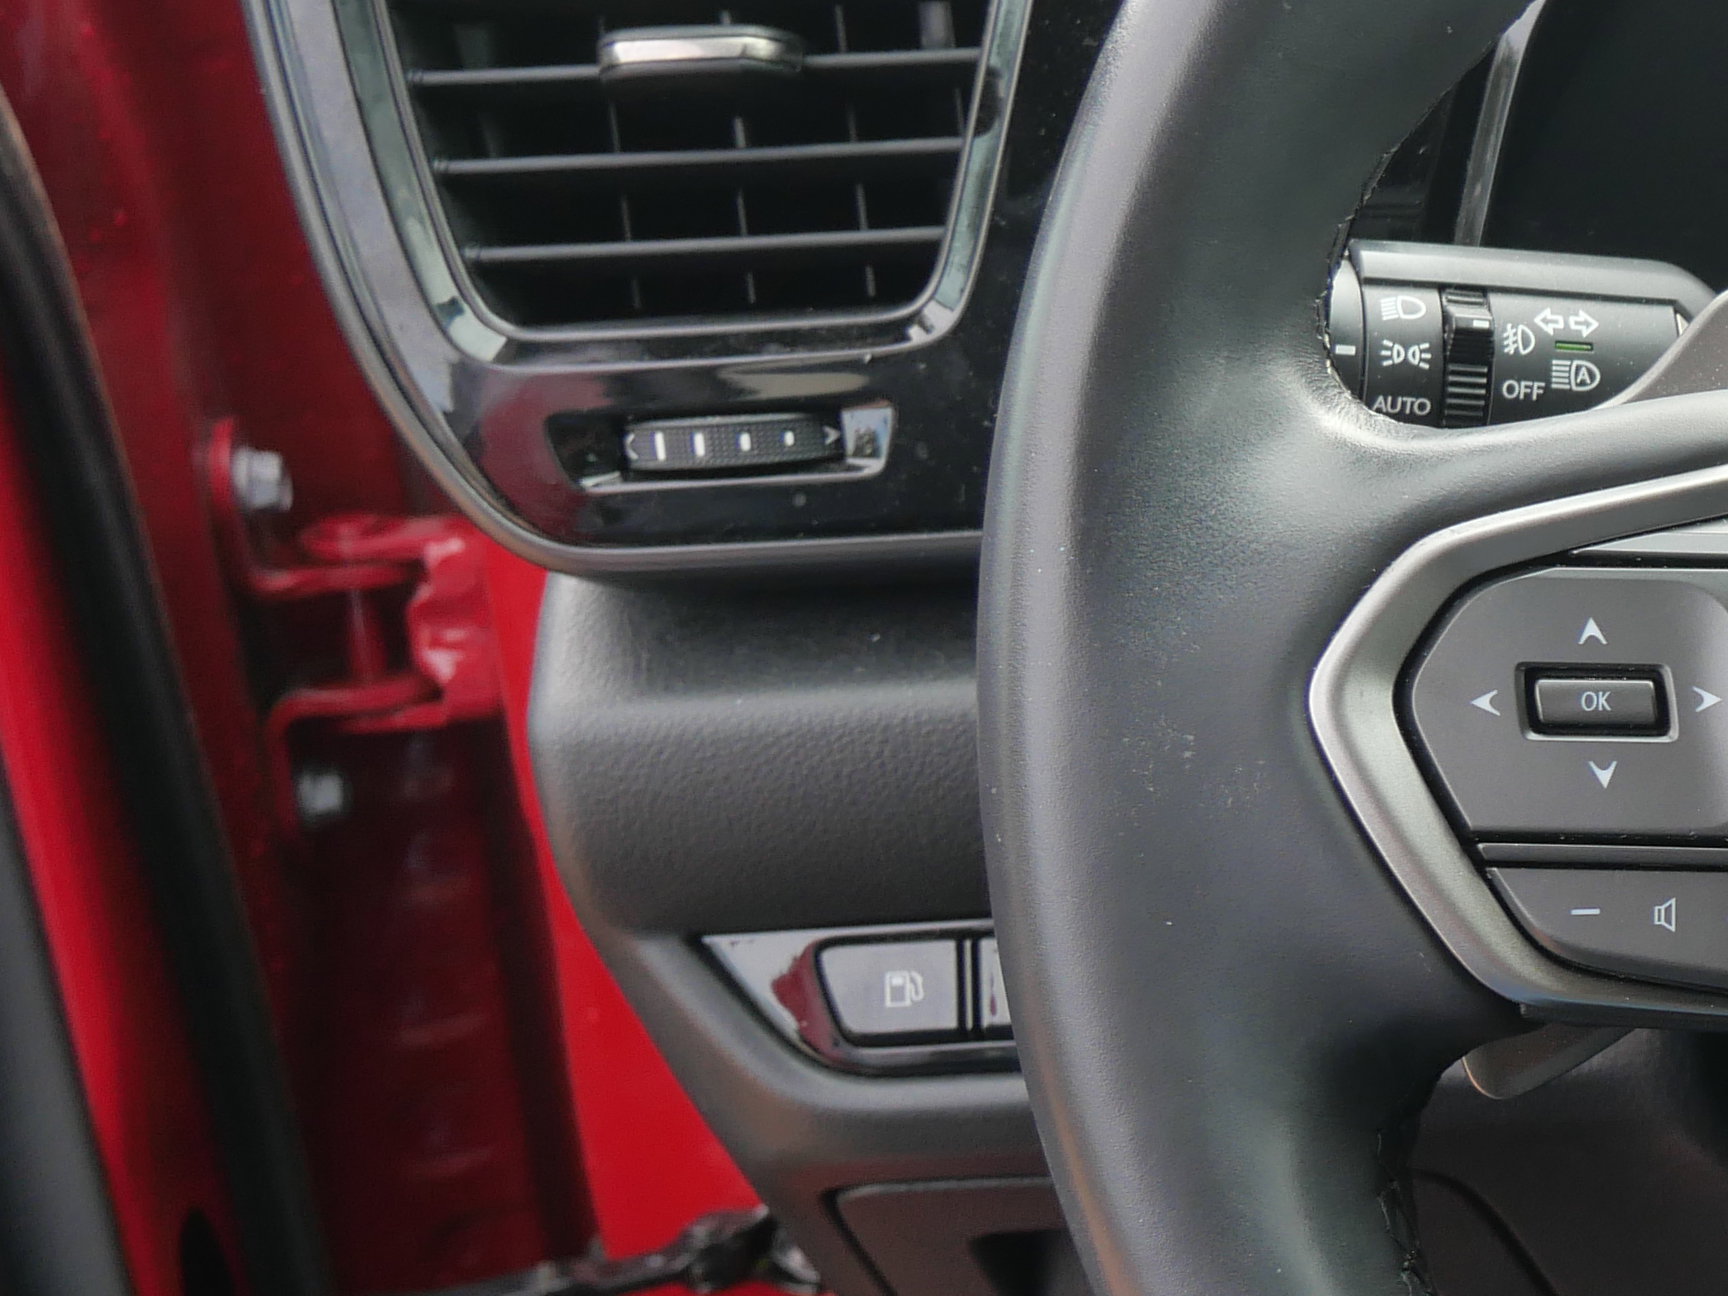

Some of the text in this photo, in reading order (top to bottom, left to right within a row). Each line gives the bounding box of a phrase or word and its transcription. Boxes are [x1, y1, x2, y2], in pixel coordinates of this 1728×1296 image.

[1502, 379, 1546, 402] OFF
[1371, 395, 1432, 416] AUTO
[1580, 690, 1612, 711] OK
